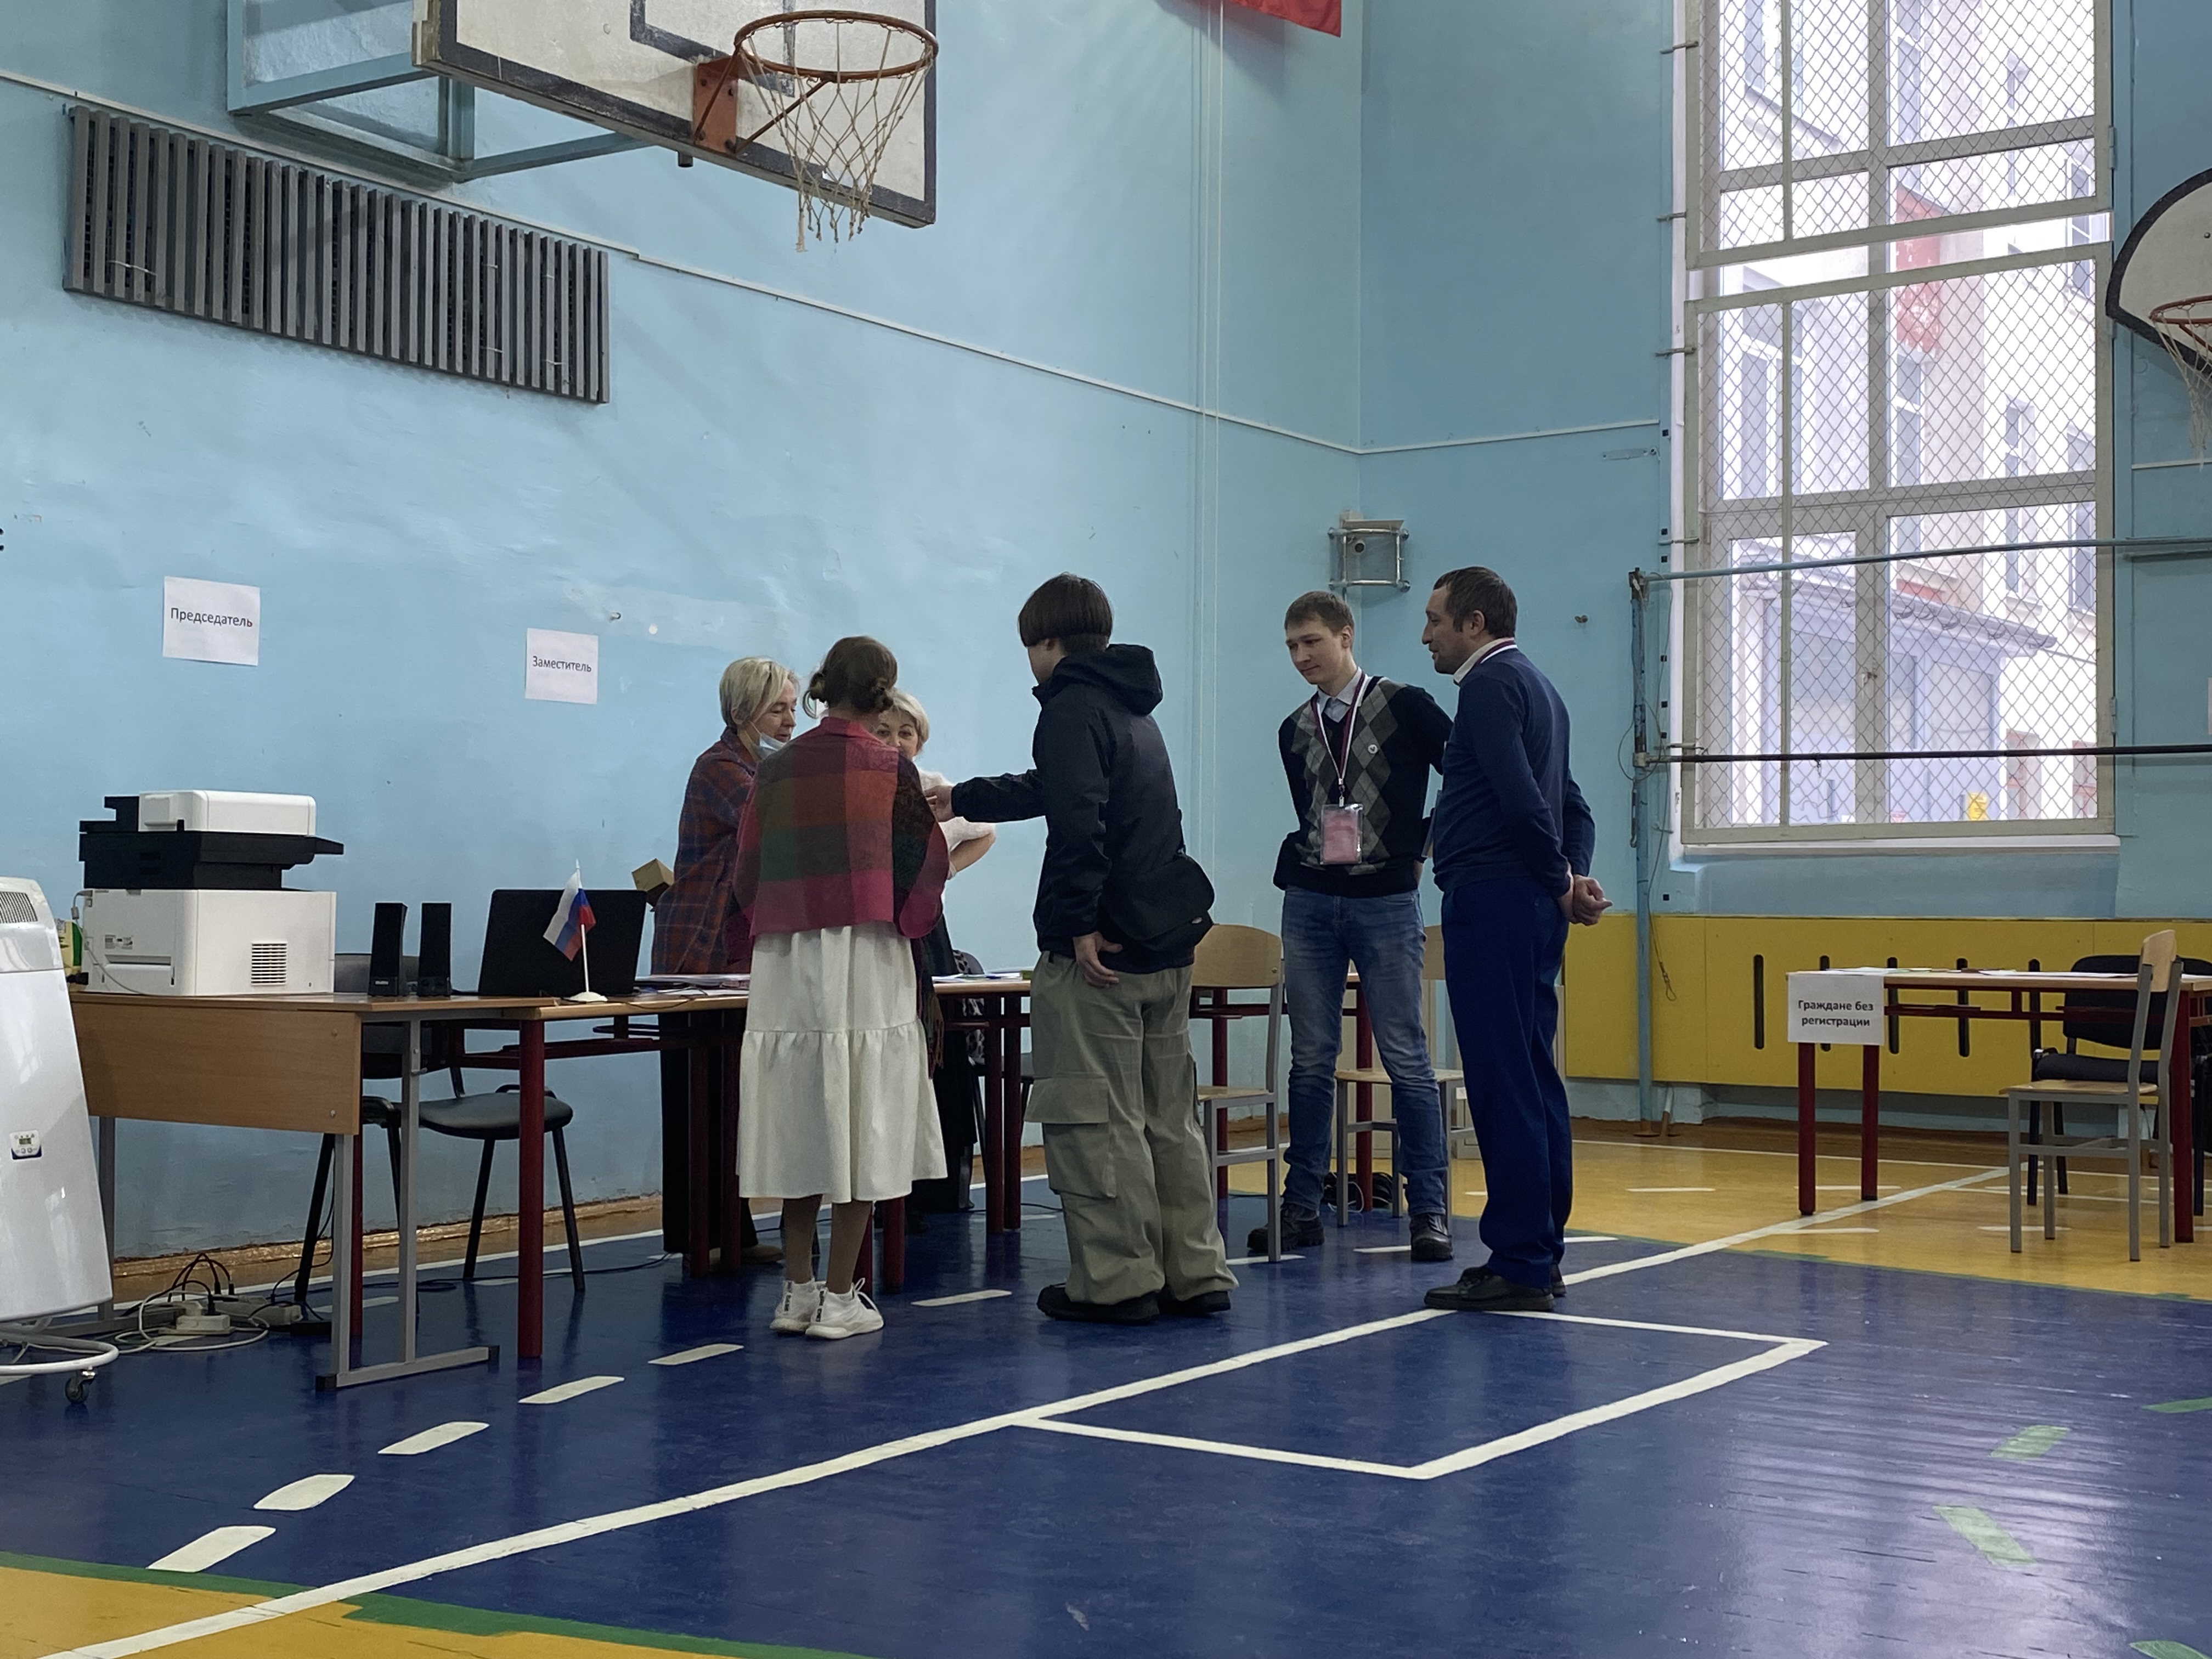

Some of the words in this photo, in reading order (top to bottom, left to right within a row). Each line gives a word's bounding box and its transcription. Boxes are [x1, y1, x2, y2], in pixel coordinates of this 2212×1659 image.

[171, 607, 253, 627] Председатель
[532, 655, 592, 672] Заместитель
[1798, 1000, 1852, 1012] Граждане
[1855, 1001, 1874, 1011] без
[1802, 1017, 1870, 1028] регистрации
